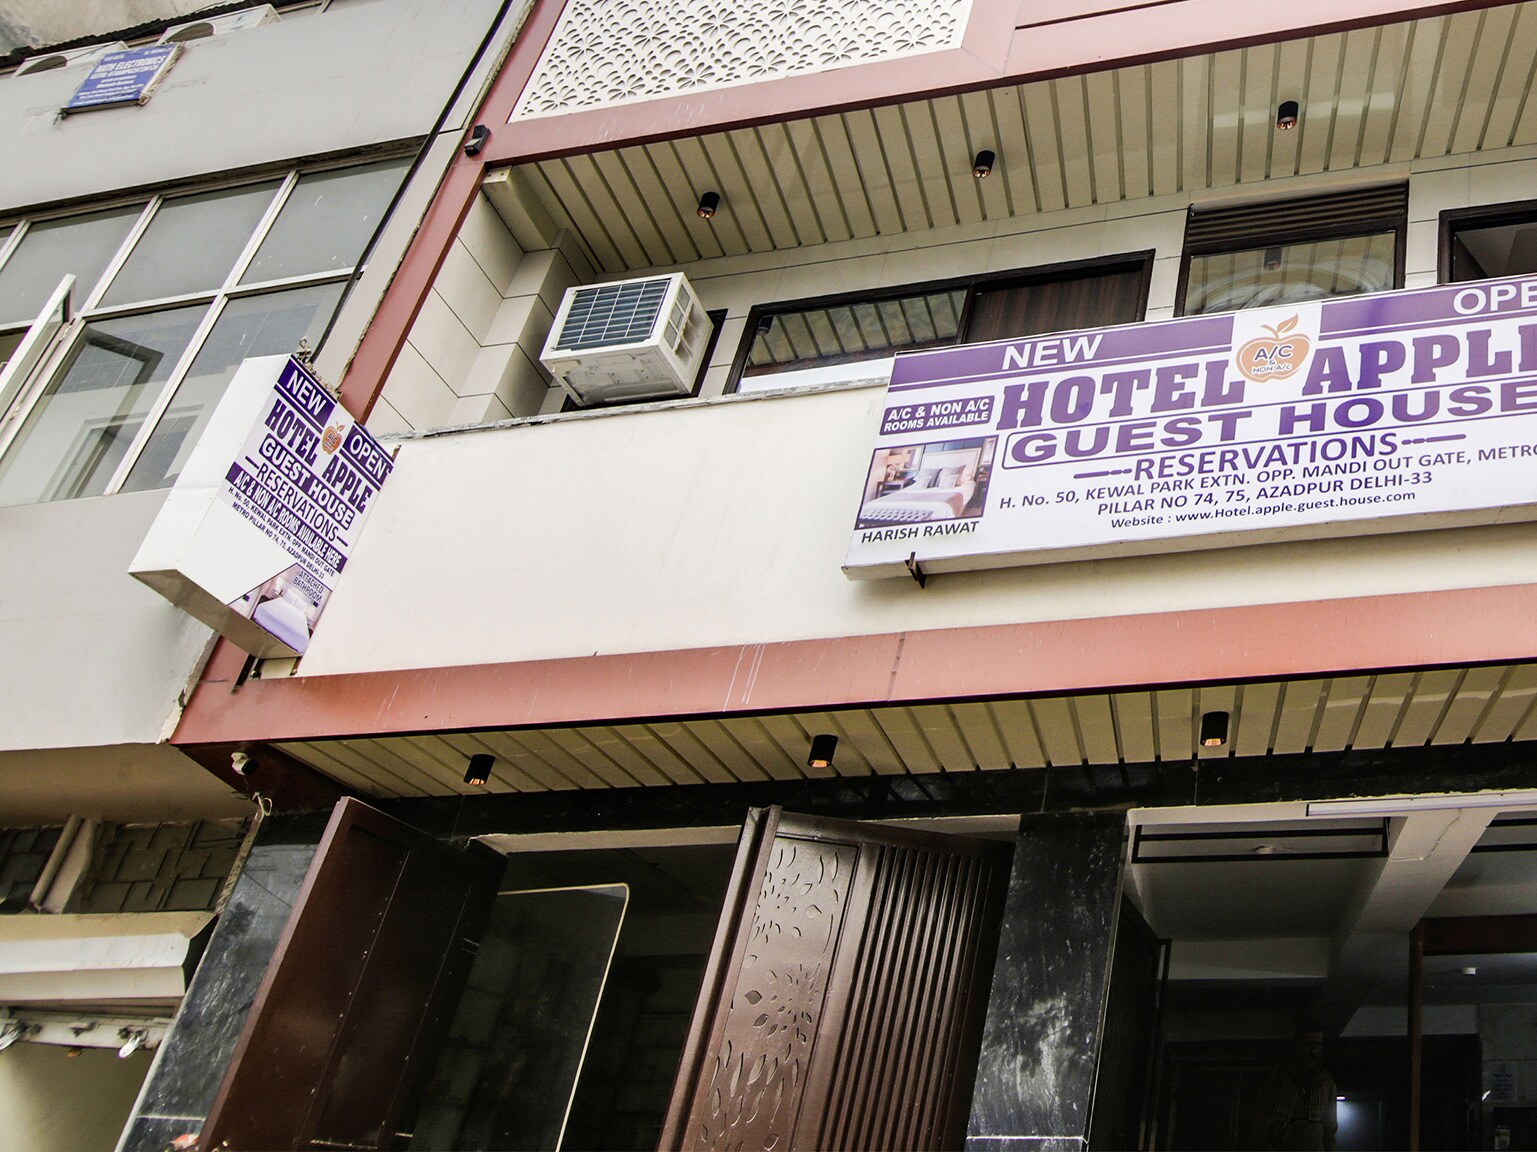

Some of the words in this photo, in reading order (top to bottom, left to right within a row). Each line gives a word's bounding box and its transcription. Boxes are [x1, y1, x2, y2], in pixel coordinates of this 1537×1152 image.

[1001, 334, 1104, 371] NEW
[1254, 345, 1293, 361] A/C
[286, 369, 327, 416] NEW
[888, 408, 912, 422] A/C
[915, 406, 927, 419] &
[930, 401, 962, 416] NON
[966, 398, 990, 413] A/C
[996, 359, 1246, 431] HOTEL
[883, 418, 924, 433] ROOMS
[926, 411, 989, 428] AVAILABLE
[1011, 410, 1253, 464] GUEST
[264, 398, 320, 468] HOTEL
[321, 454, 373, 514] APPLE
[350, 434, 387, 481] OPEN
[1134, 432, 1398, 481] RESERVATIONS
[246, 480, 256, 497] &
[251, 485, 271, 510] NON
[256, 462, 339, 542] RESERVATIONS
[261, 436, 311, 488] GUEST
[308, 480, 355, 528] HOUSE
[1000, 497, 1016, 509] H.
[1022, 494, 1049, 507] No.
[1055, 490, 1080, 504] 50,
[1085, 484, 1145, 501] KEWAL
[1150, 478, 1196, 494] PARK
[1200, 473, 1250, 489] EXTN.
[1257, 467, 1295, 483] OPP.
[1302, 461, 1367, 479] MANDI
[1373, 456, 1413, 471] OUT
[1418, 451, 1471, 467] GATE,
[1097, 498, 1155, 515] PILLAR
[1160, 494, 1188, 509] NO
[1194, 492, 1219, 507] 74,
[1225, 489, 1250, 503] 75,
[1256, 480, 1344, 501] AZADPUR
[1350, 471, 1432, 491] DELHI-33
[250, 504, 266, 522] KEWAL
[266, 518, 279, 530] PARK
[1111, 515, 1164, 528] Website
[1176, 491, 1416, 523] www.Hotel.apple.guest.house.com
[232, 501, 250, 519] METRO
[249, 514, 266, 532] PILLAR
[286, 546, 307, 566] AZADPUR
[861, 527, 919, 544] HARISH
[923, 521, 980, 537] RAWAT
[292, 576, 323, 603] BATHROOM
[298, 570, 324, 594] ATTACHED
